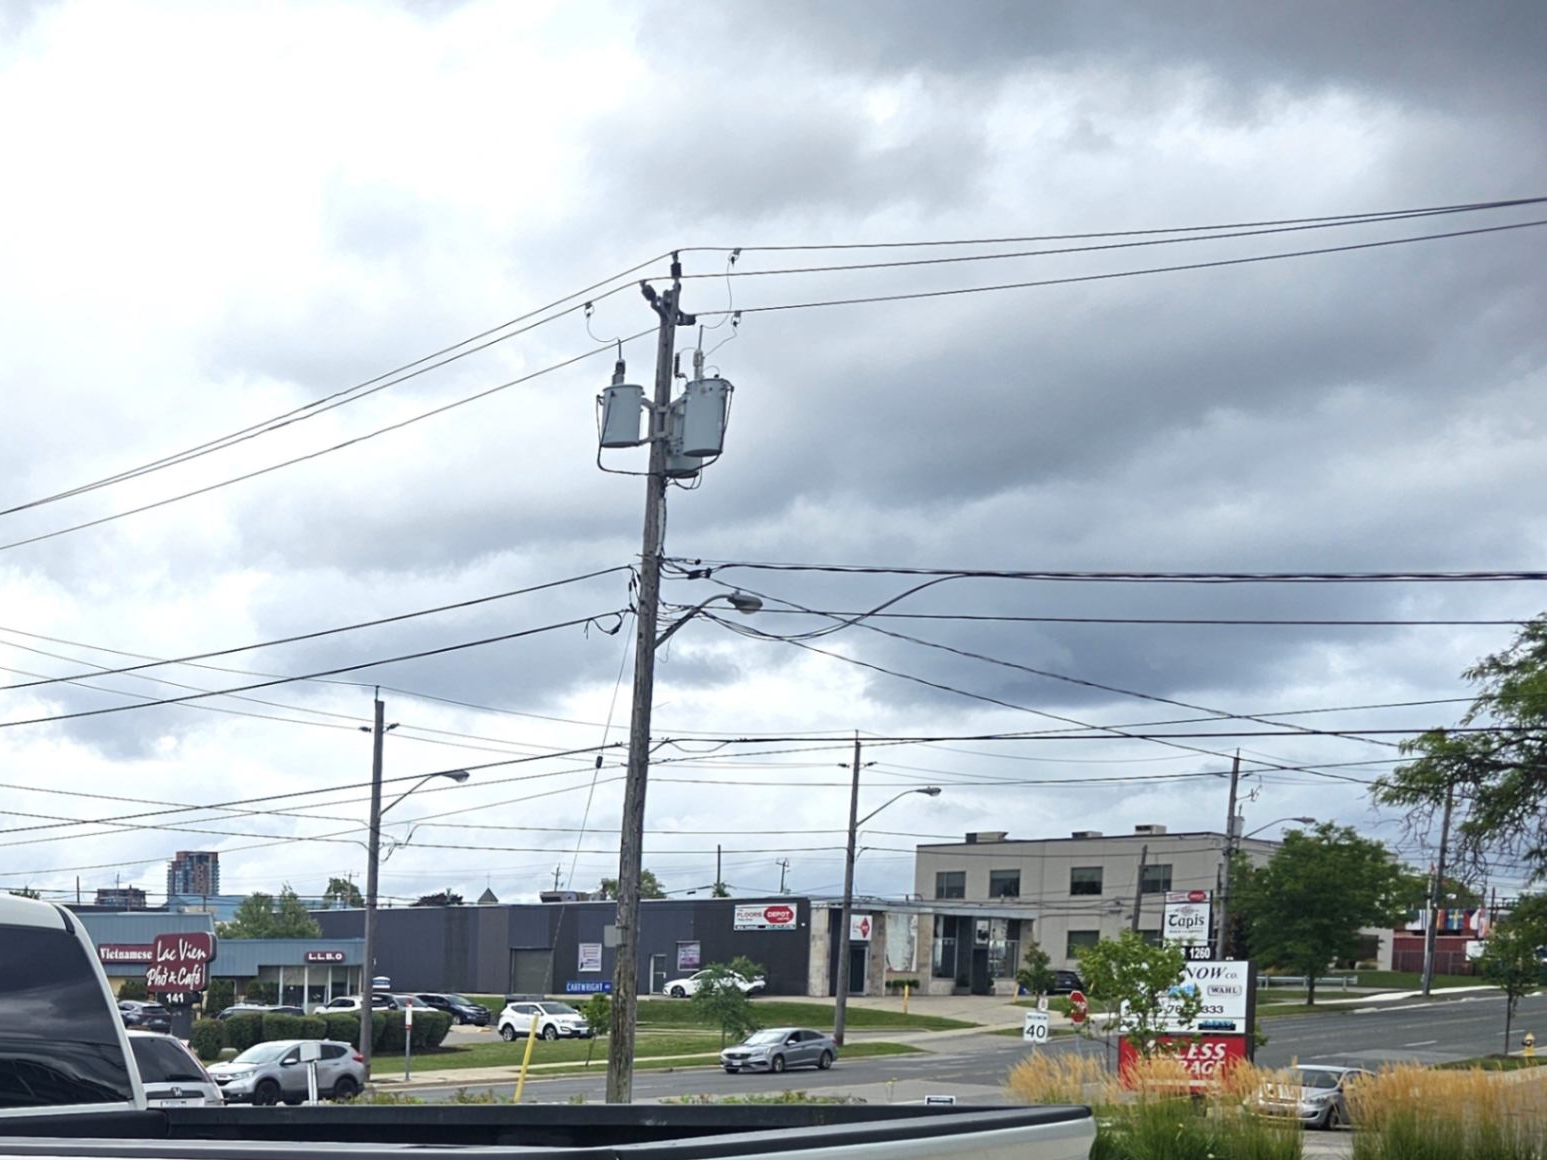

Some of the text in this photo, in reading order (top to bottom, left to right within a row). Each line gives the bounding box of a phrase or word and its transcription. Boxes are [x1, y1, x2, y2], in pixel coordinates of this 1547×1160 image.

[767, 910, 791, 918] DEPOT
[1168, 913, 1205, 929] Tapis
[99, 947, 153, 960] Vietnamese
[156, 940, 177, 962] Lac
[168, 971, 177, 984] &
[1211, 986, 1237, 994] WAHL
[166, 992, 184, 1003] 141
[1025, 1024, 1046, 1039] 40
